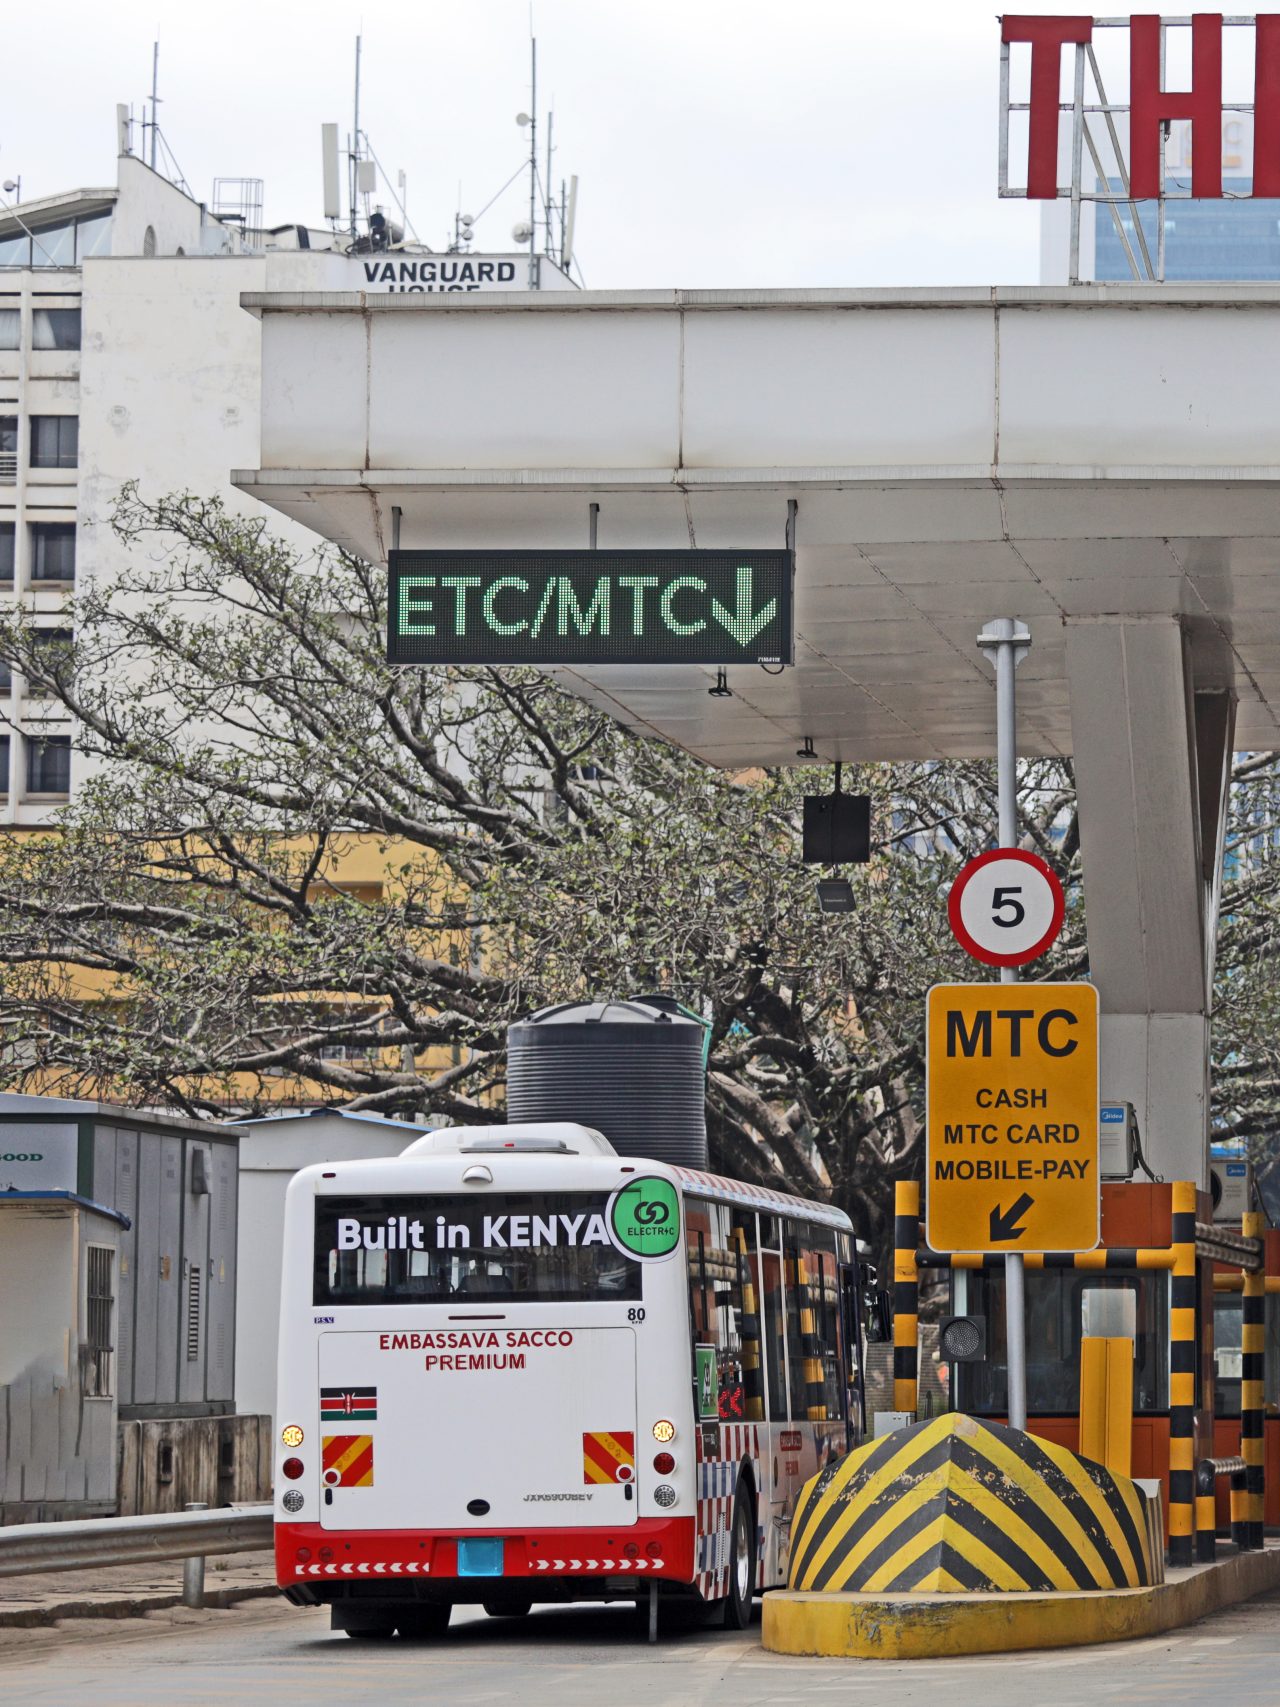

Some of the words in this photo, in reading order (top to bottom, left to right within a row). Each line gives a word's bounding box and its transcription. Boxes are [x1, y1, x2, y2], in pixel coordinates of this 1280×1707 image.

[363, 262, 516, 283] VANGUARD
[398, 576, 707, 639] ETC/MTC
[991, 886, 1025, 928] 5
[946, 1008, 1079, 1058] MTC
[975, 1088, 1048, 1109] CASH
[944, 1124, 999, 1145] MTC
[1006, 1123, 1080, 1144] CARD
[934, 1159, 1090, 1181] MOBILE-PAY
[337, 1216, 424, 1250] Built
[436, 1215, 470, 1249] in
[483, 1213, 612, 1248] KENYA
[627, 1307, 646, 1321] 80
[379, 1332, 500, 1350] EMBASSAVA
[506, 1330, 573, 1348] SACCO
[425, 1353, 526, 1371] PREMIUM
